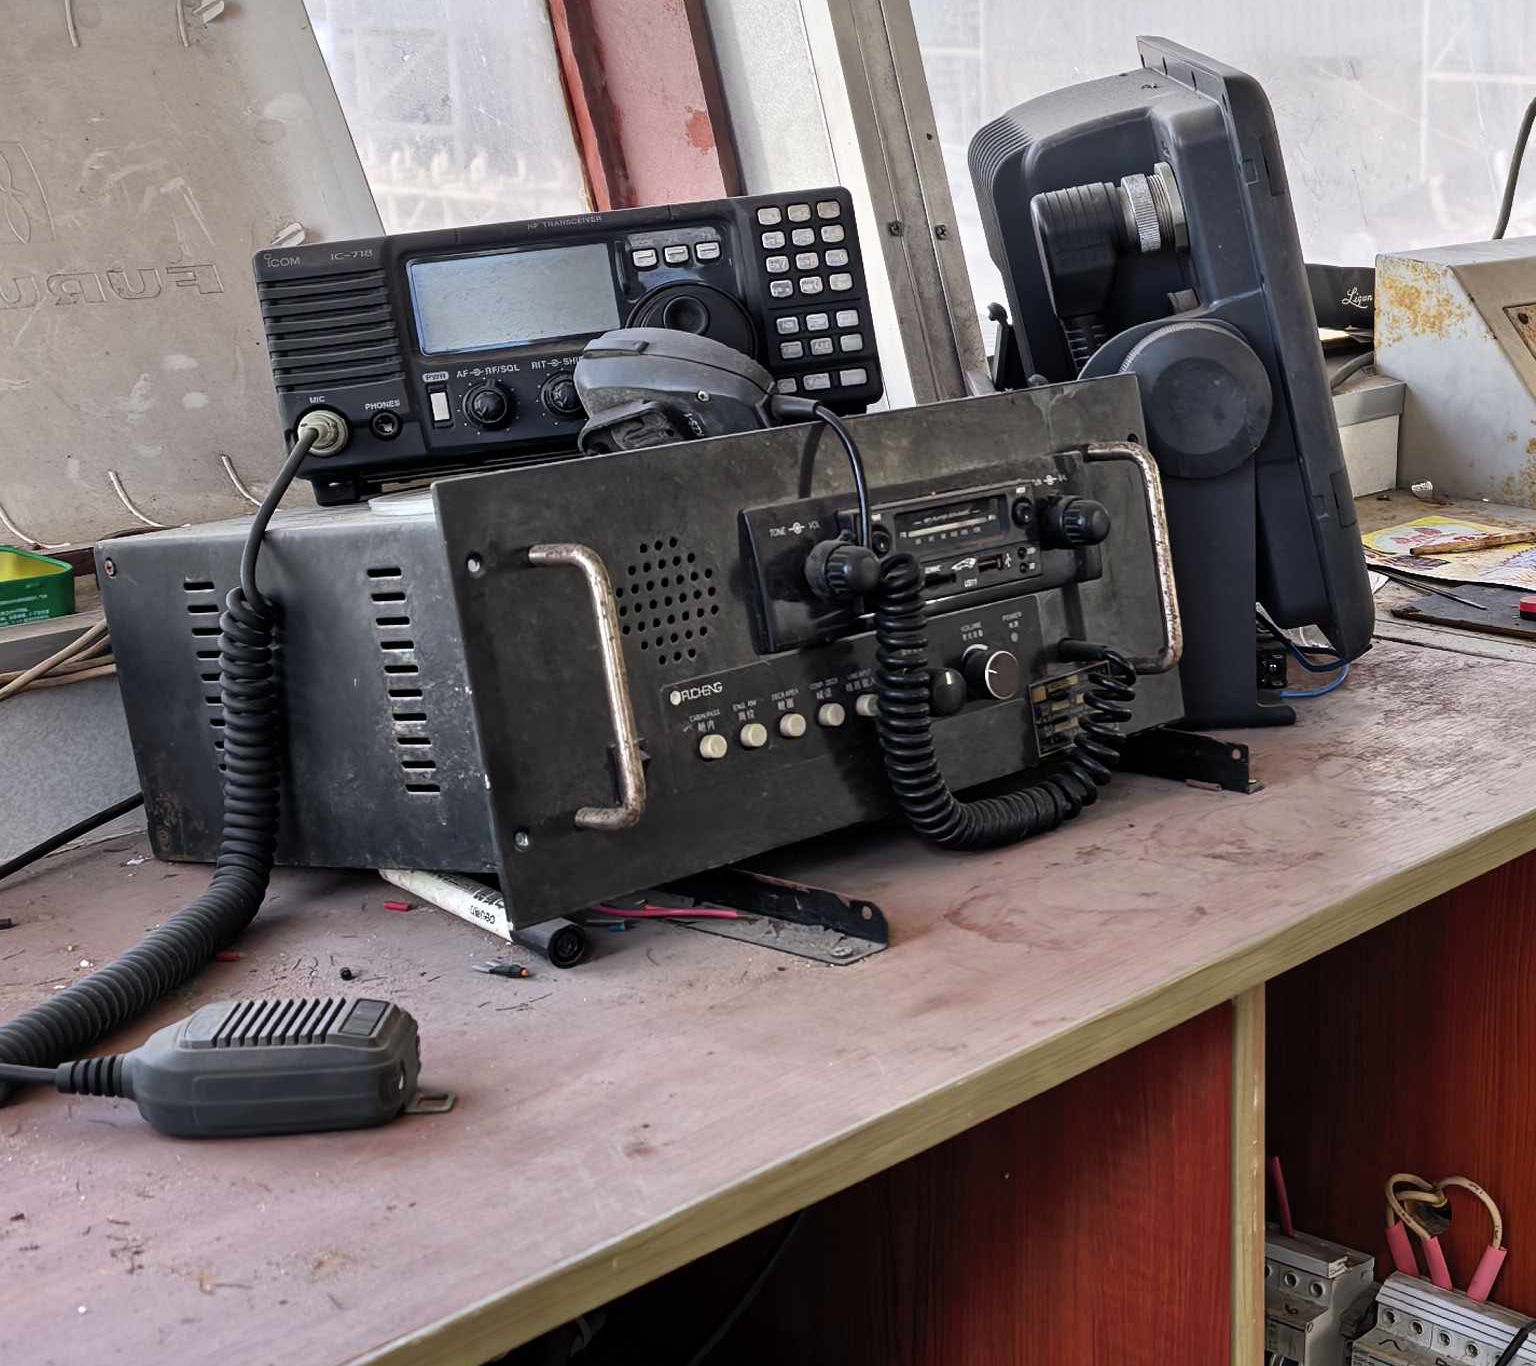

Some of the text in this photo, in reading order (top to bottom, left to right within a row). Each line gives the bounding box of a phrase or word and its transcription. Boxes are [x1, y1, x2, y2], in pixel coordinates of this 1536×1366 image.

[330, 249, 373, 261] IC-718
[456, 364, 520, 379] AF RF/SQL
[309, 395, 325, 404] MIC
[365, 399, 401, 411] PHONES
